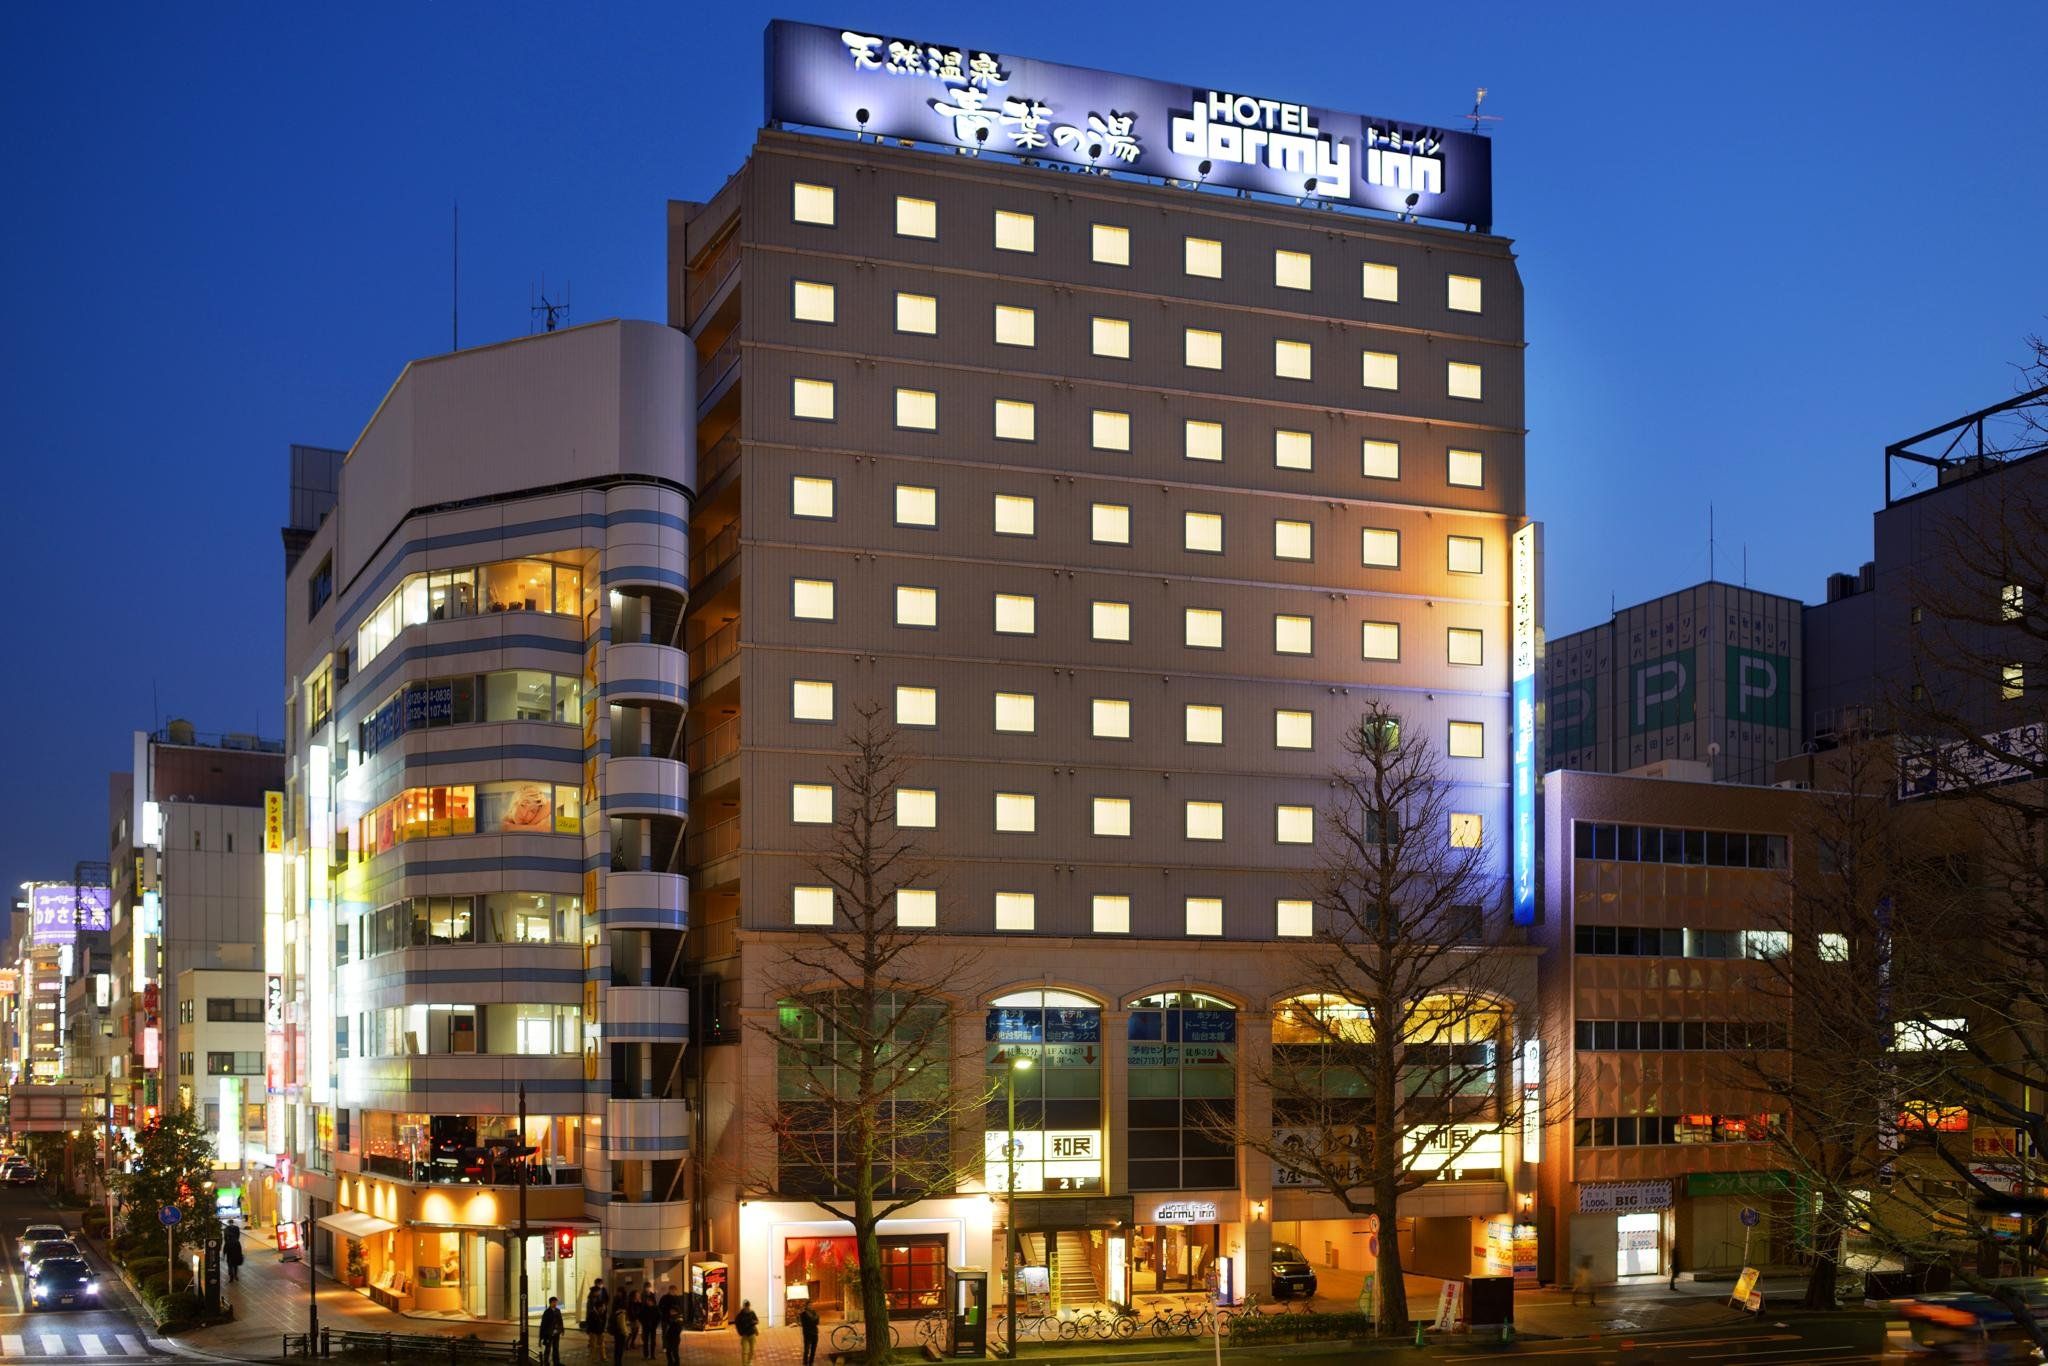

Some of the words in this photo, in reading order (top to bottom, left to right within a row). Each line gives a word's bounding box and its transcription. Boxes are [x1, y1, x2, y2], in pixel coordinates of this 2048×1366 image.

[841, 31, 1010, 87] 天然温泉
[933, 87, 1141, 163] 青葉の湯
[1208, 91, 1319, 137] HOTEL
[1172, 101, 1350, 199] dormy
[1368, 148, 1442, 194] inn
[1367, 127, 1441, 156] ドーミーイン
[1636, 660, 1687, 726] P
[1739, 655, 1777, 713] P
[1053, 1137, 1092, 1156] 和民
[1158, 1208, 1195, 1222] dormy
[1615, 1196, 1638, 1206] BIG
